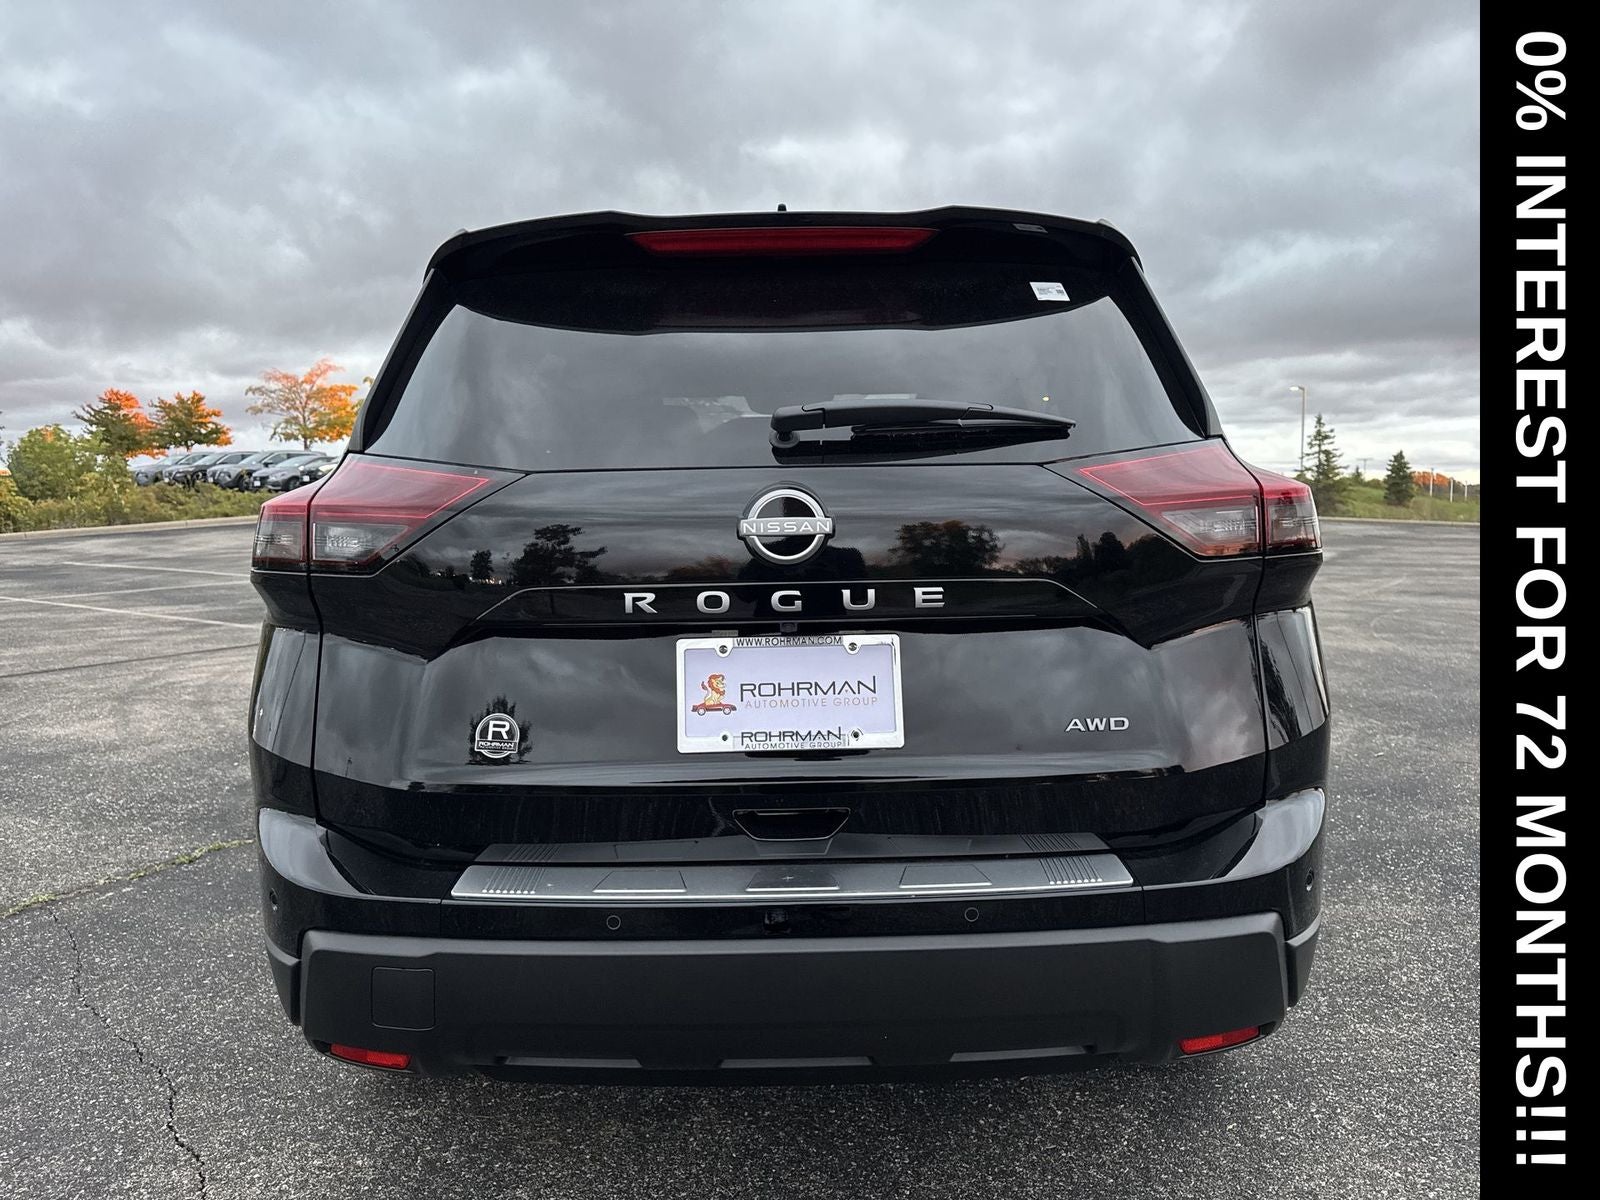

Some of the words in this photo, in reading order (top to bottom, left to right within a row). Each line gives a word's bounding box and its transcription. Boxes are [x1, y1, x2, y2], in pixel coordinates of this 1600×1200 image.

[742, 519, 832, 534] NISSAN
[623, 586, 946, 615] ROGUE
[736, 636, 842, 647] WWW.ROHRMAN.COM
[740, 675, 876, 702] ROHRMAN
[745, 698, 828, 709] AUTOMOTIVE
[833, 696, 878, 707] GROUP
[487, 720, 510, 741] R
[1065, 716, 1130, 732] AWD
[741, 726, 842, 746] ROHRMAN
[744, 741, 806, 750] AUTOMOTIVE
[808, 740, 842, 749] GROUP
